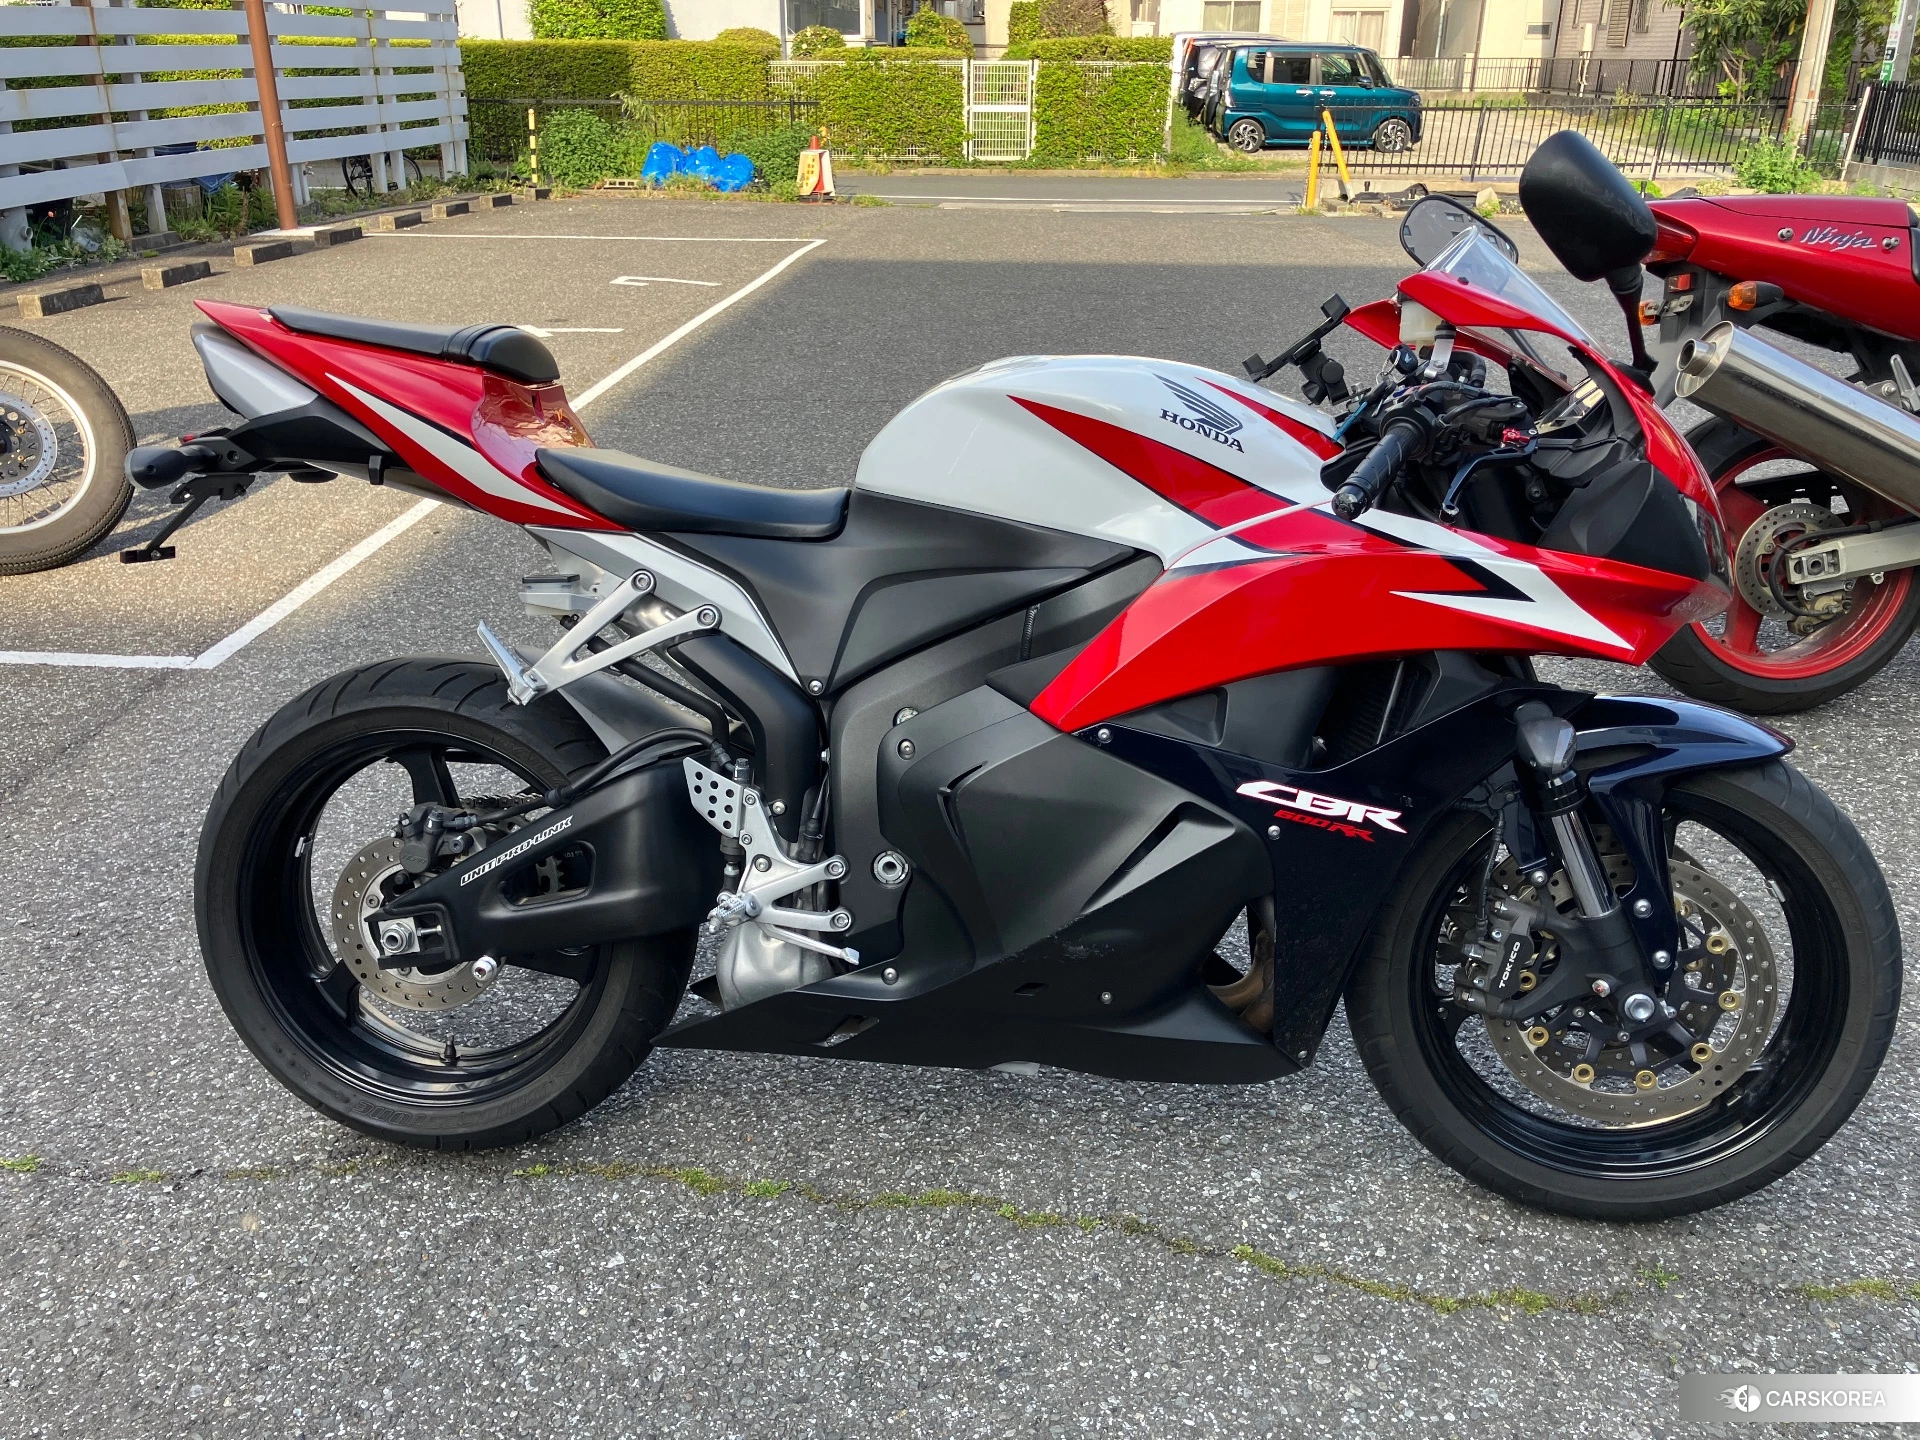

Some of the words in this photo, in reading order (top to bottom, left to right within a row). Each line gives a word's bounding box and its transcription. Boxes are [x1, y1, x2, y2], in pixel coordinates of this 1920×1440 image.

[1800, 226, 1877, 252] Ninja
[1159, 408, 1245, 454] HONDA
[1235, 781, 1408, 834] CBR
[1273, 809, 1375, 843] 600RR
[460, 857, 496, 887] UNIT
[1498, 941, 1521, 989] TOKICO
